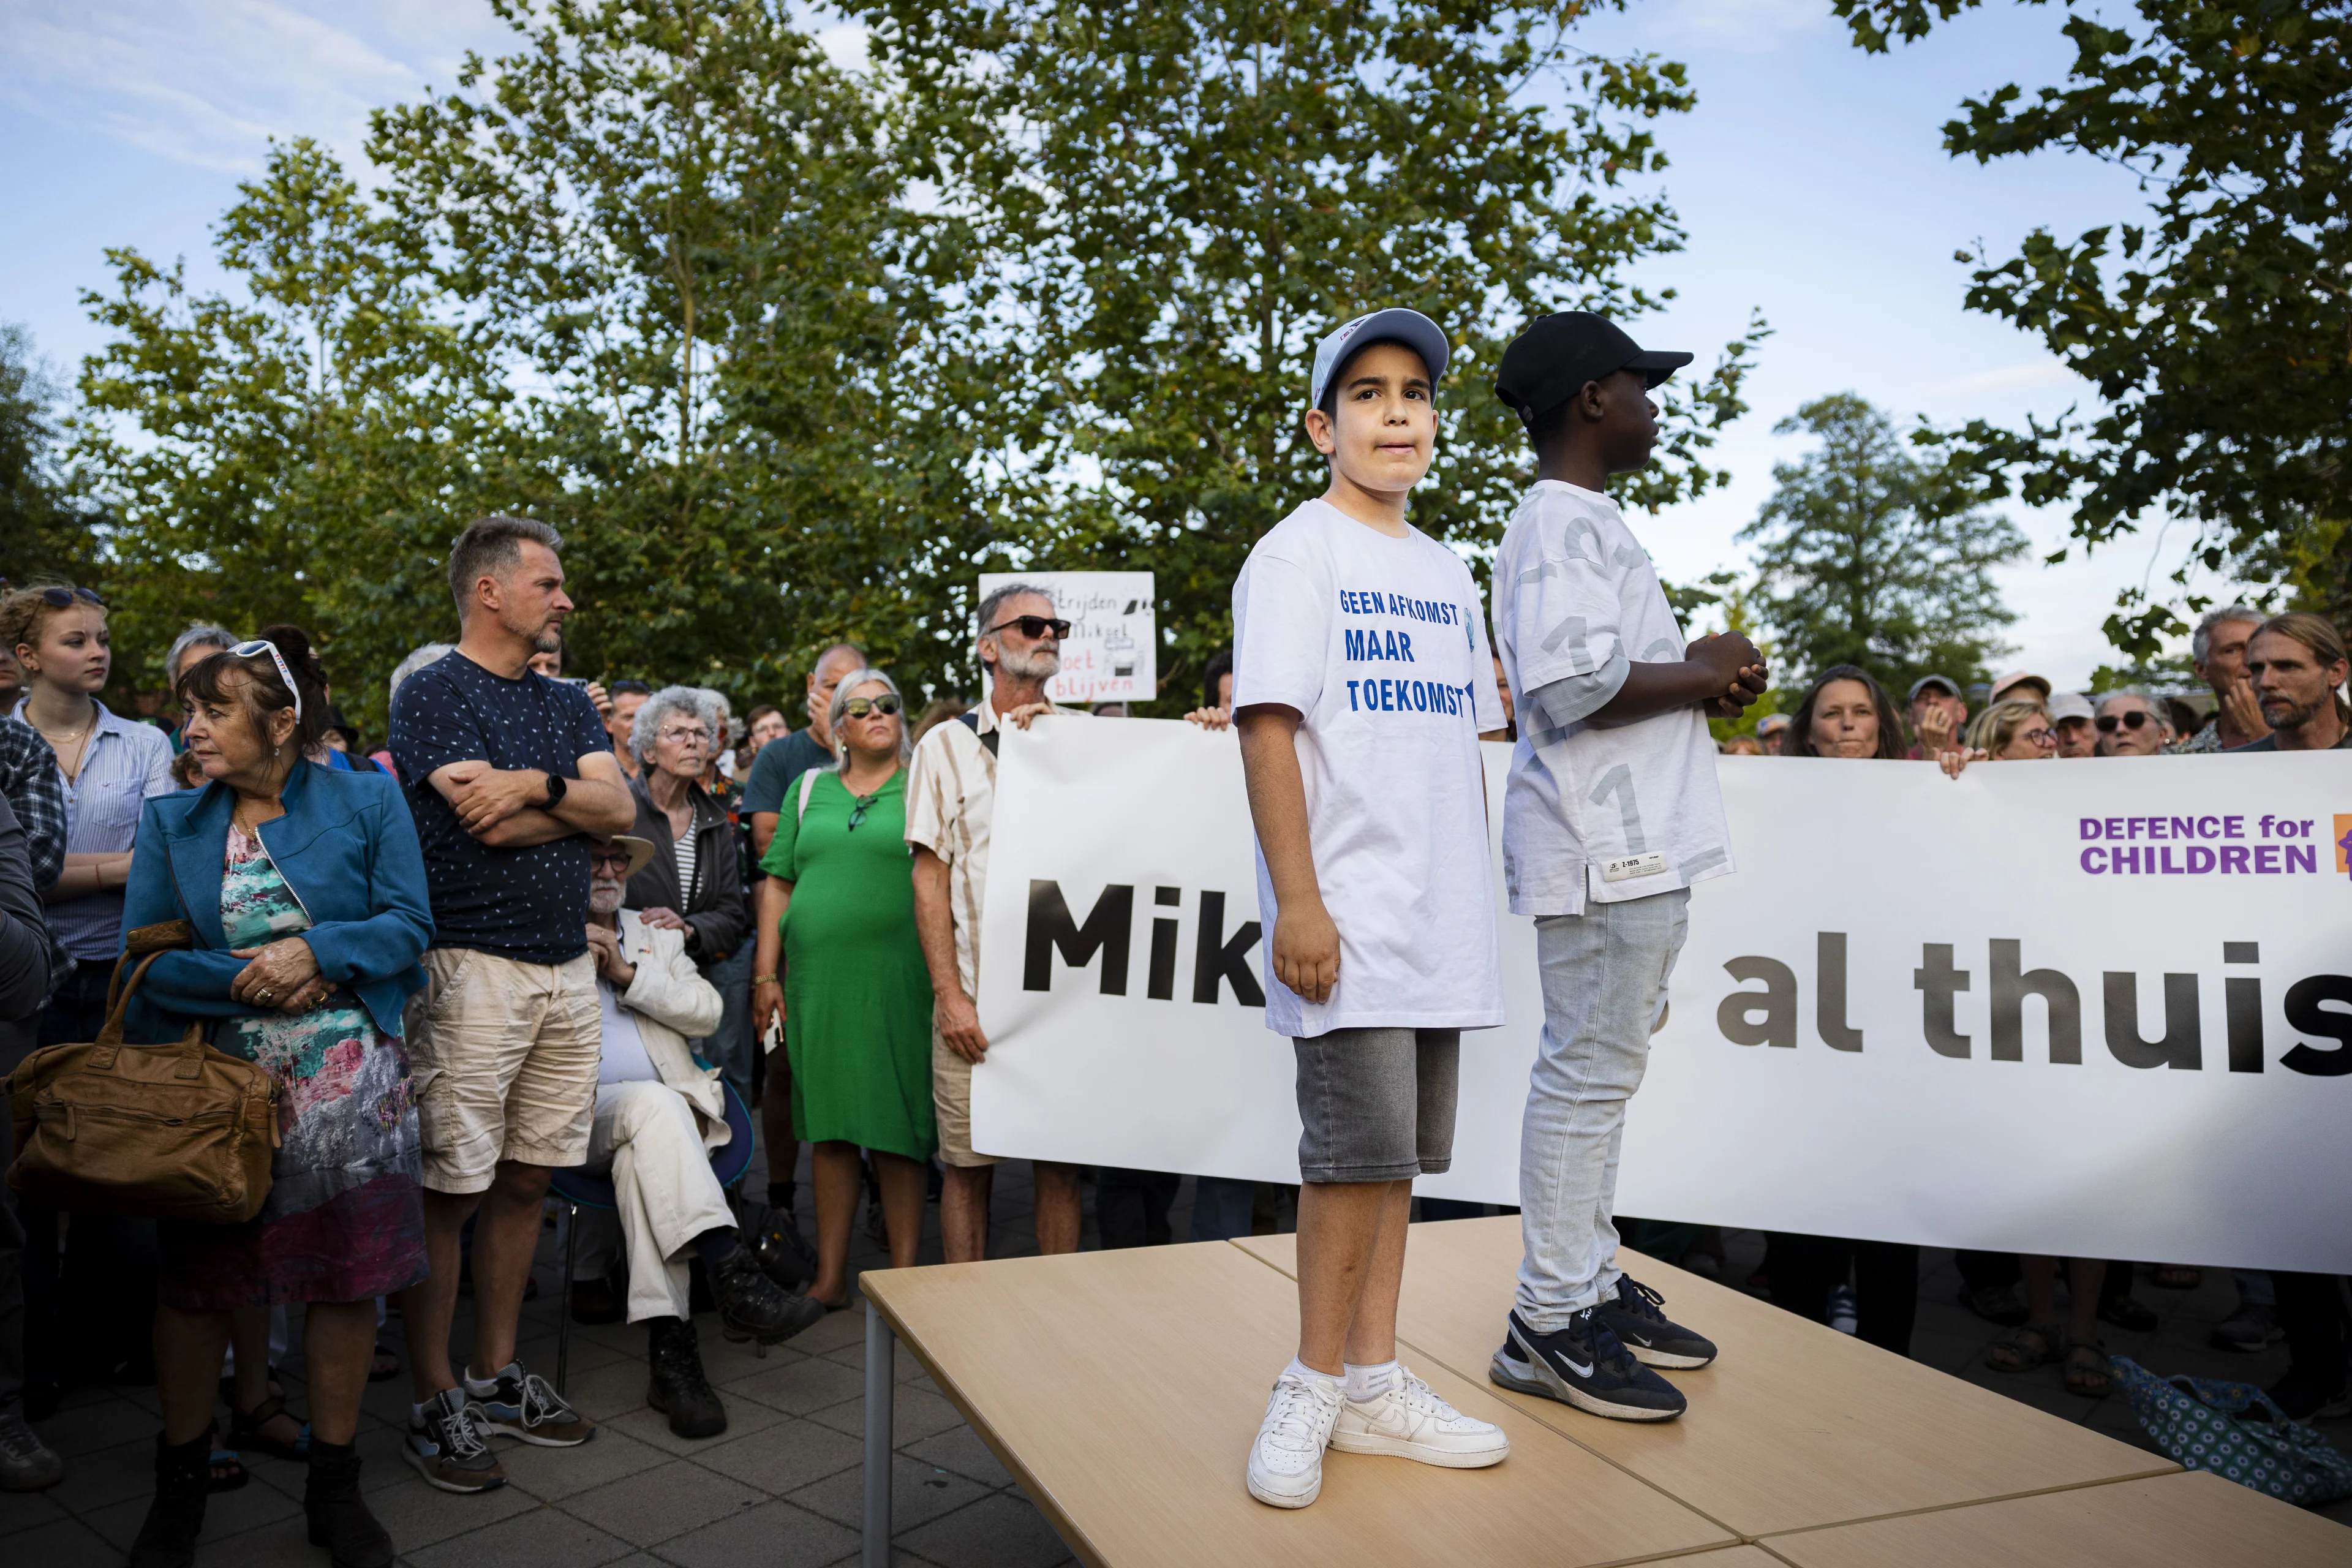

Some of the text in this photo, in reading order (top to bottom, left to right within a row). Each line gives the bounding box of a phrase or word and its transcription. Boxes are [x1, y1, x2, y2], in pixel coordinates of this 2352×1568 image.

[1340, 589, 1459, 625] GEEN AFKOMST
[1063, 650, 1096, 671] oet
[1345, 629, 1415, 662] MAAR
[1055, 676, 1133, 702] blijven
[1346, 679, 1464, 718] TOEKOMST
[2080, 815, 2315, 840] DEFENCE for
[2081, 845, 2318, 875] CHILDREN
[1023, 879, 2352, 1077] Mik al thuis
